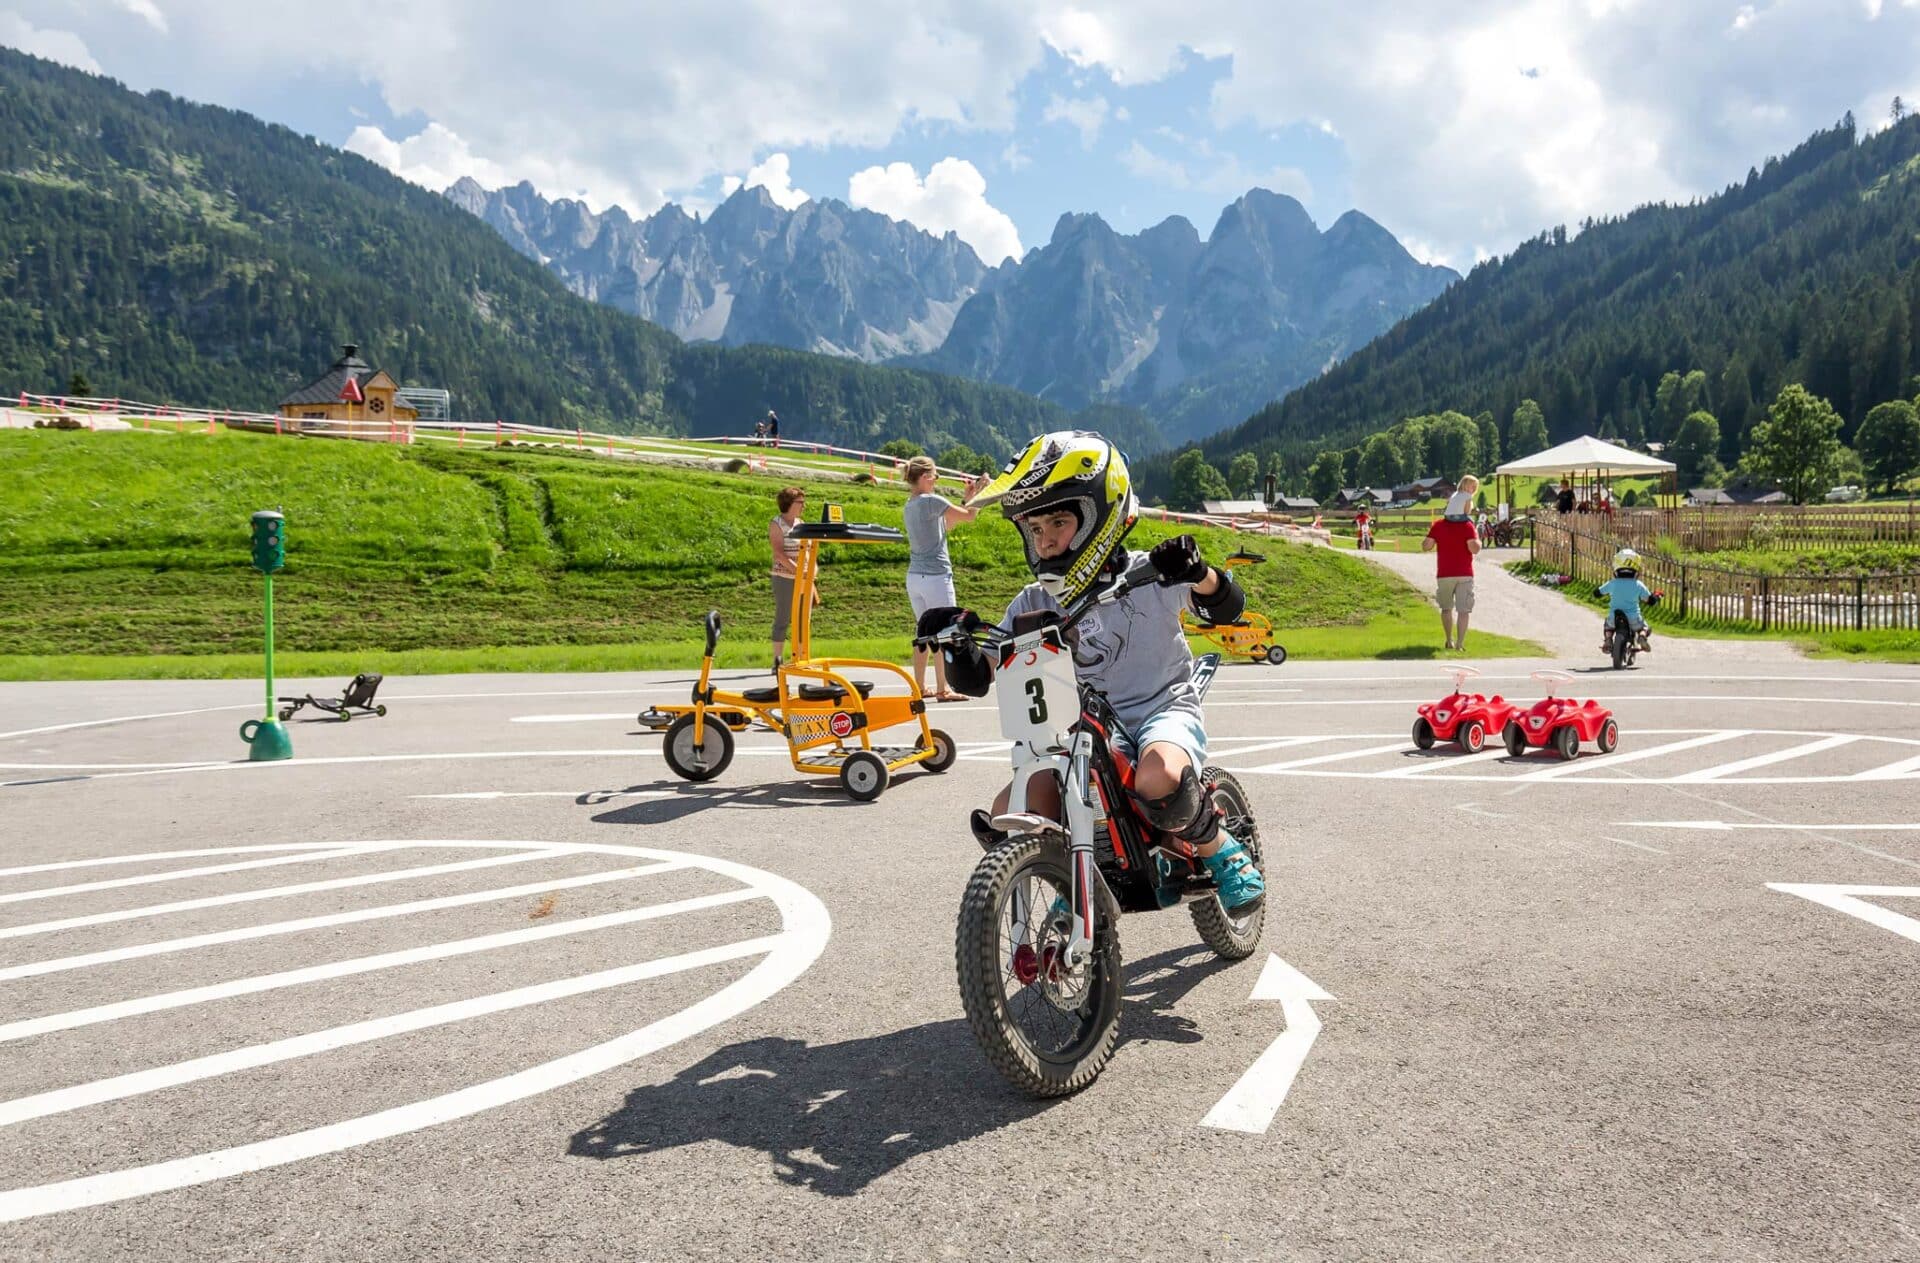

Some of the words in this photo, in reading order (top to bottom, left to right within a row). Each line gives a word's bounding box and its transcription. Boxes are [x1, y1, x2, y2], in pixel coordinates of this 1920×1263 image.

[1025, 678, 1047, 724] 3
[796, 721, 825, 734] TAX
[833, 720, 849, 730] STOP
